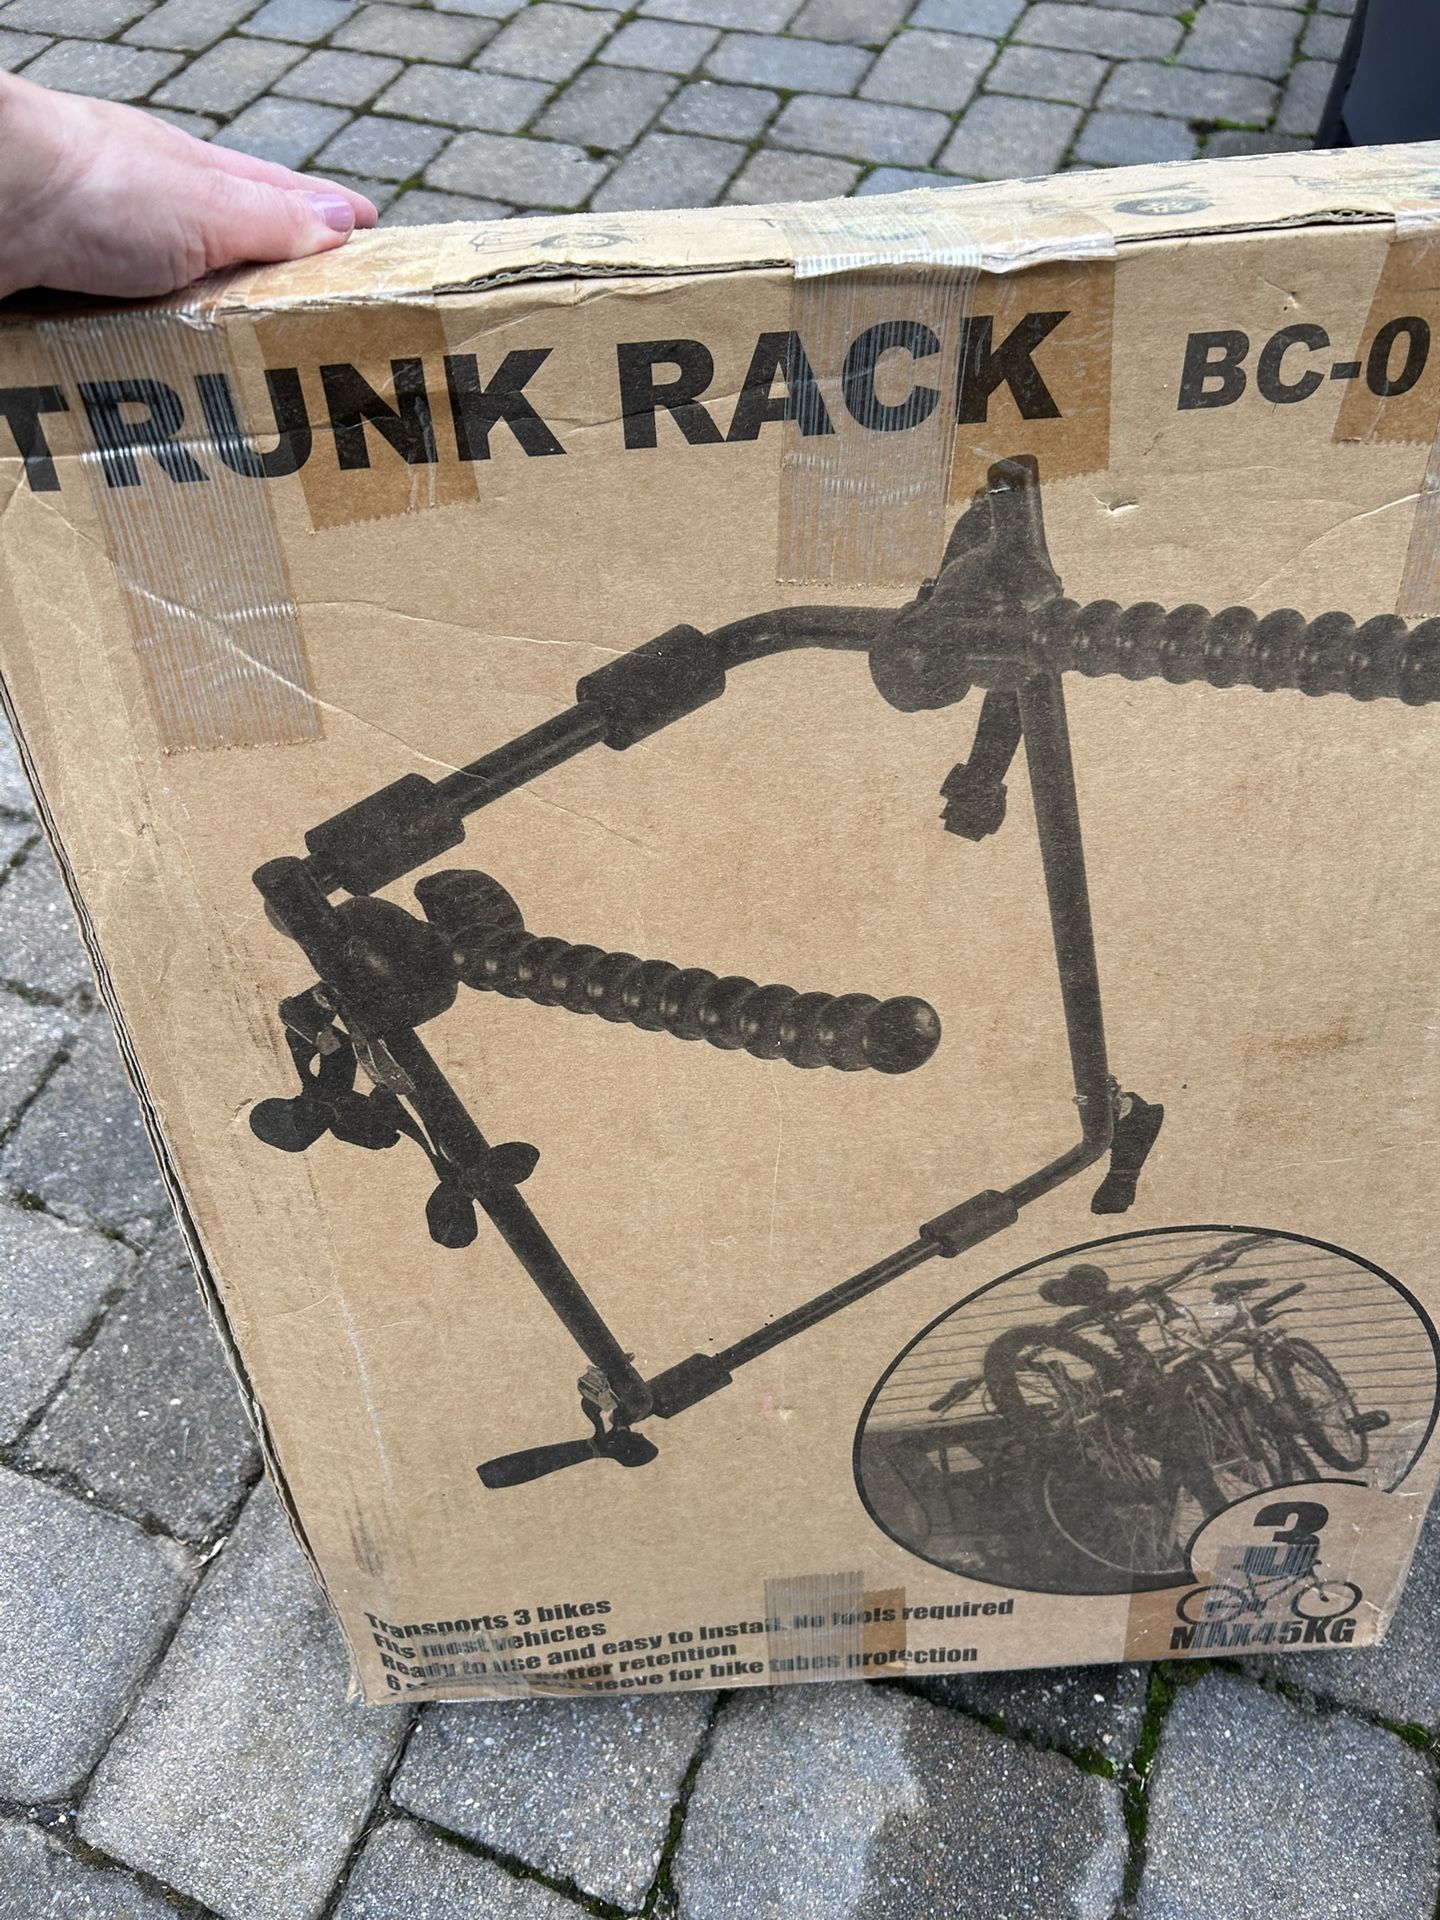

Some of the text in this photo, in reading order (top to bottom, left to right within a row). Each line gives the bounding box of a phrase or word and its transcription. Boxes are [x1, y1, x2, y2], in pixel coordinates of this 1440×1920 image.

[0, 310, 1431, 492] TRUNK RACK BC-0
[1244, 1501, 1329, 1576] 3
[364, 1600, 612, 1639] Transports 3 bikes
[380, 1652, 456, 1679] Ready
[463, 1660, 487, 1675] to
[493, 1656, 542, 1675] use
[547, 1643, 596, 1666] and
[602, 1635, 663, 1656] easy
[668, 1630, 694, 1645] to
[793, 1613, 825, 1630] No
[831, 1607, 897, 1627] tools
[902, 1599, 1015, 1621] required
[421, 1637, 490, 1658] most
[493, 1623, 607, 1651] vehicles
[386, 1673, 402, 1691] 6
[619, 1644, 738, 1674] retention
[668, 1668, 705, 1683] for
[710, 1660, 765, 1679] bike
[769, 1655, 841, 1673] tubes
